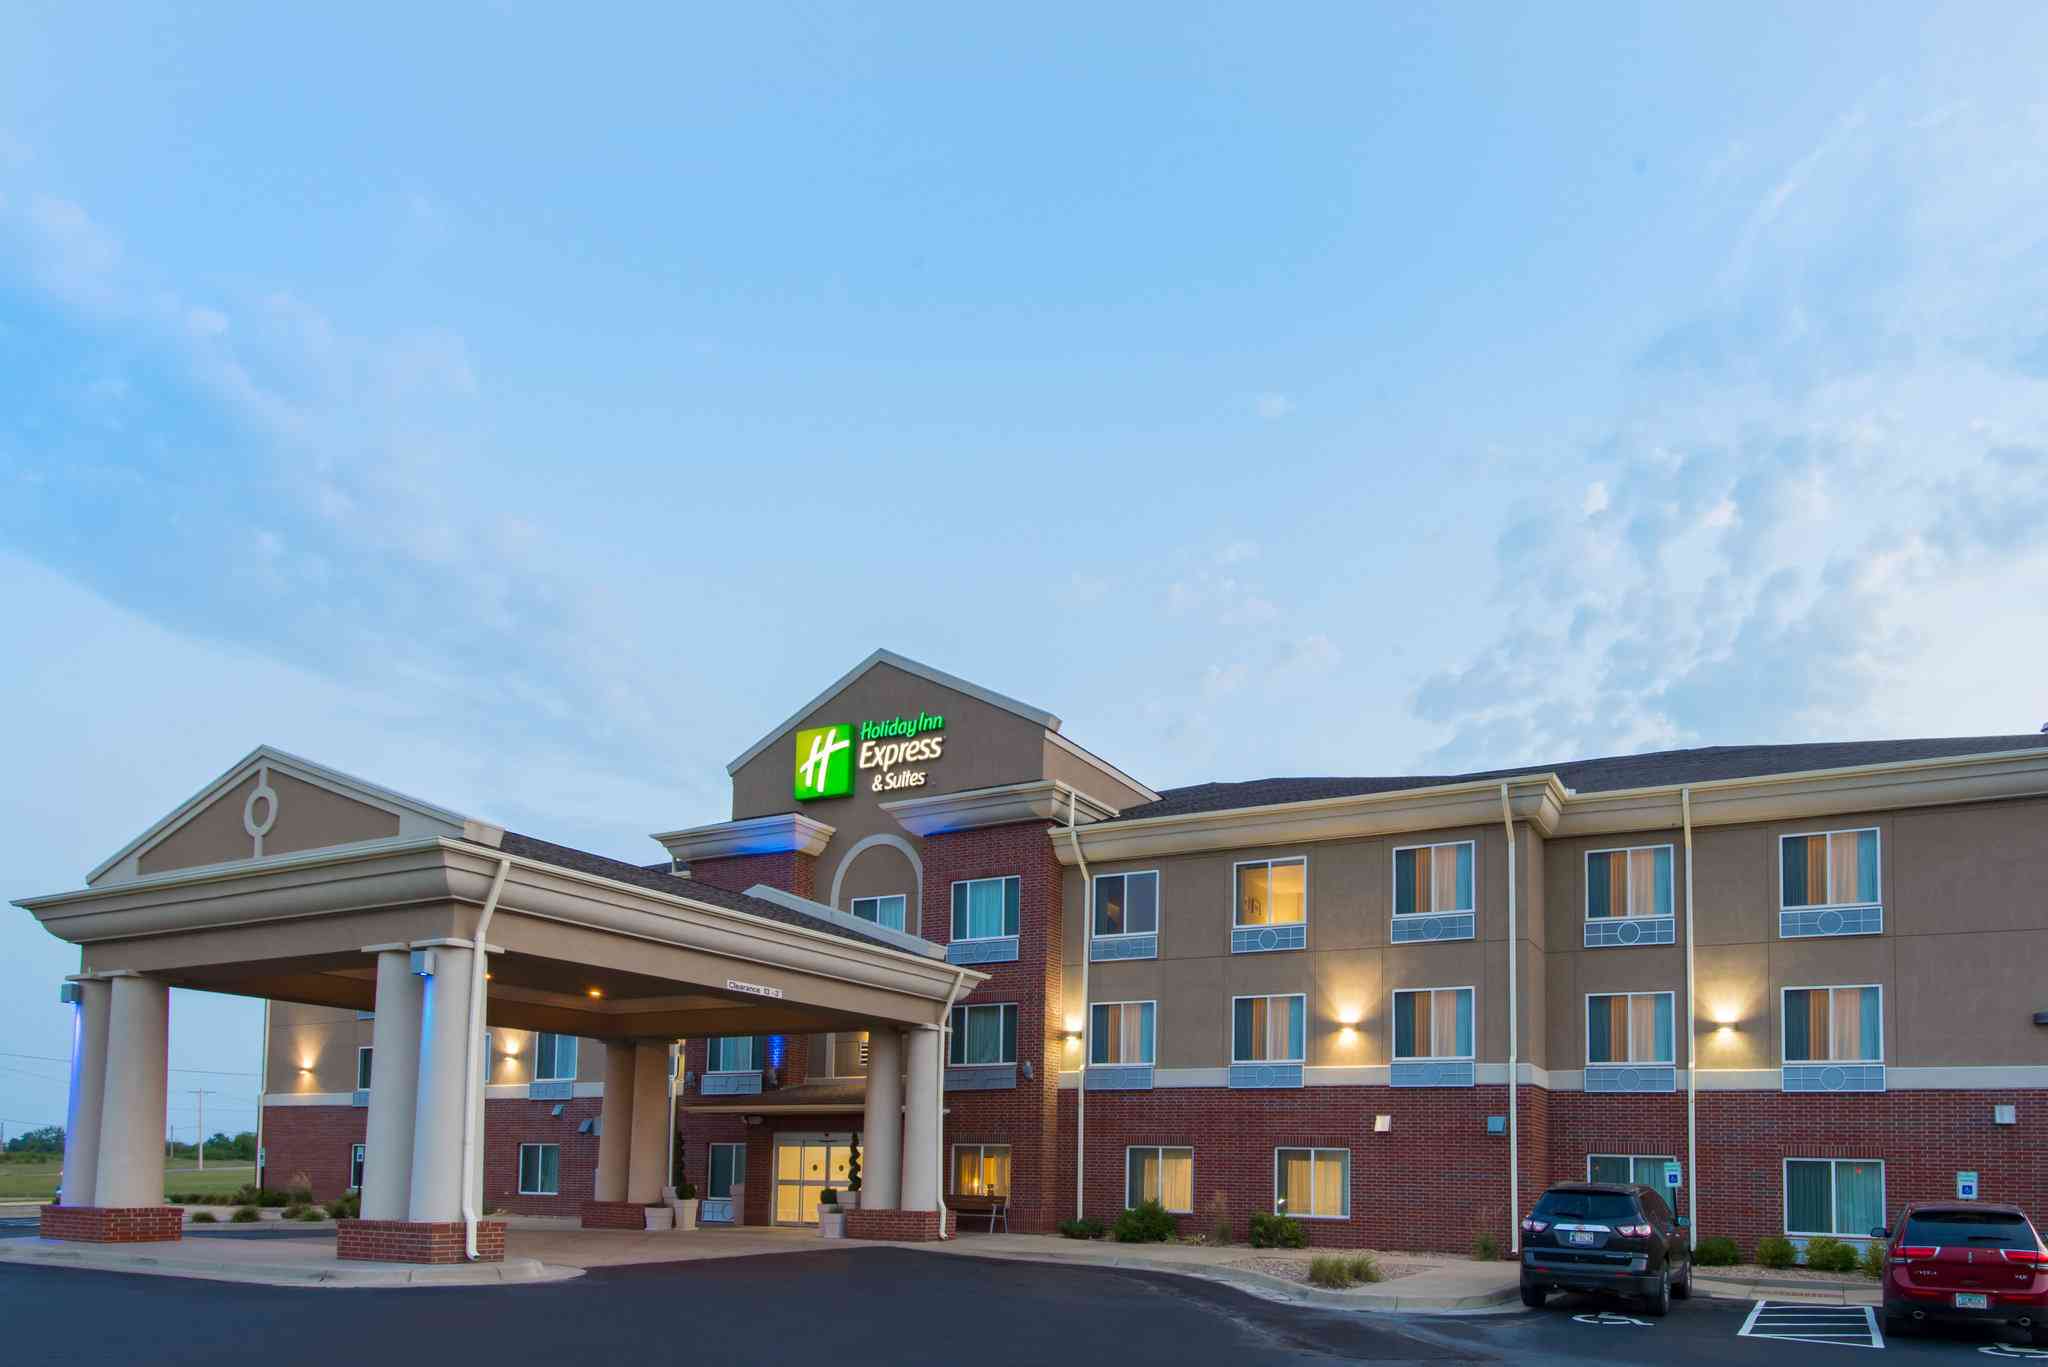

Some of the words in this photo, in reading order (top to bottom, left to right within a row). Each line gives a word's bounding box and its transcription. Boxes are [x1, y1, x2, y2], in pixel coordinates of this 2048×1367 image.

[861, 716, 917, 740] Holiday
[918, 711, 944, 731] Inn
[859, 736, 943, 772] Express
[871, 774, 883, 792] &
[884, 769, 926, 790] Suites
